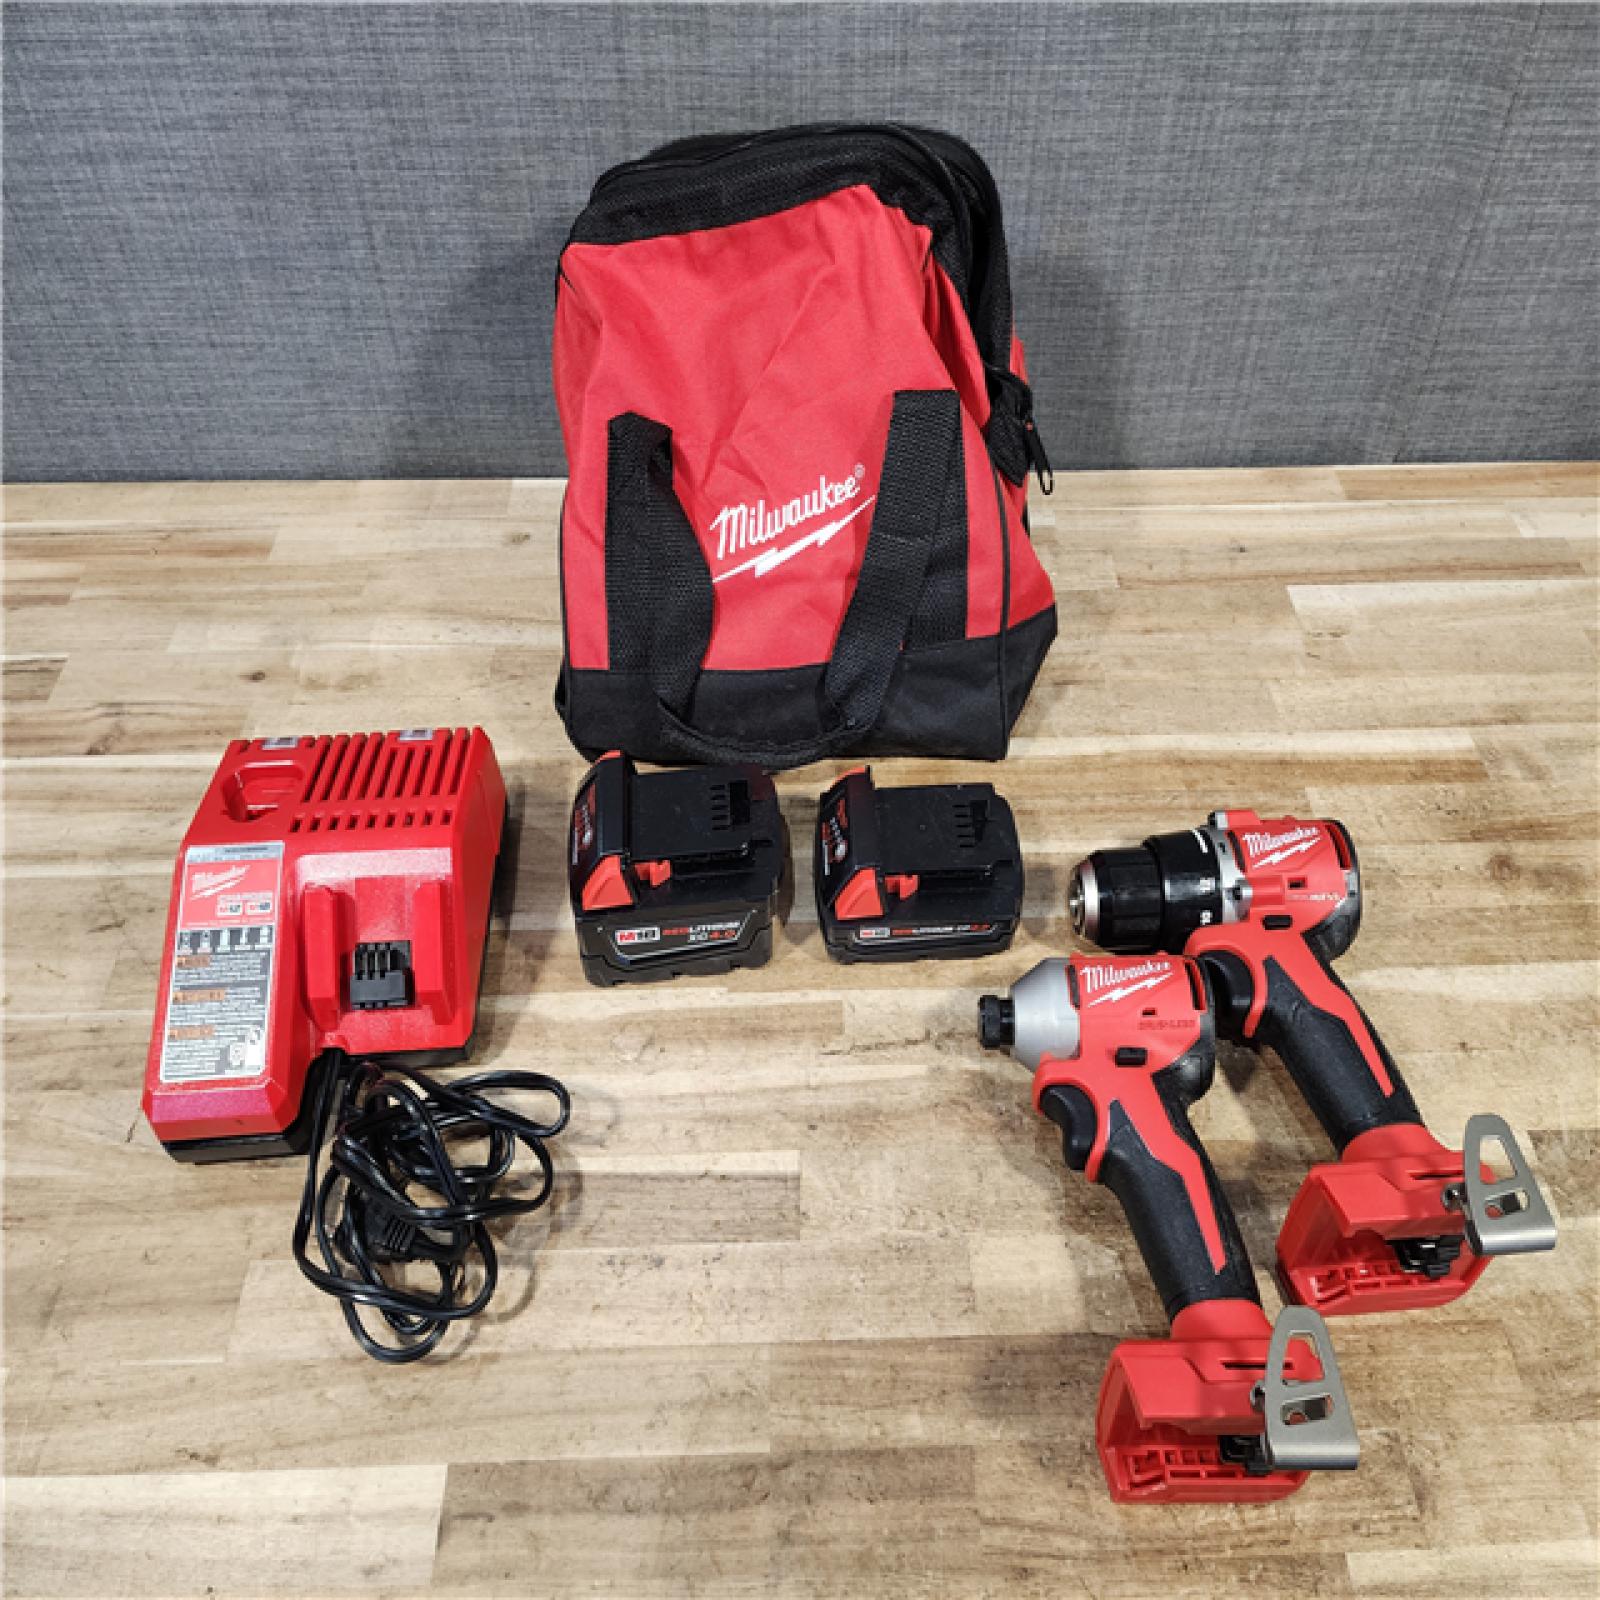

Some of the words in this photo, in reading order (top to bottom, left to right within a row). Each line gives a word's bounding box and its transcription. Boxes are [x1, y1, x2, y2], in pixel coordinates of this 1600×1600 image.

[709, 474, 860, 560] Milwaukee
[1242, 826, 1320, 858] Milwaukee
[1079, 959, 1171, 994] Milwaukee
